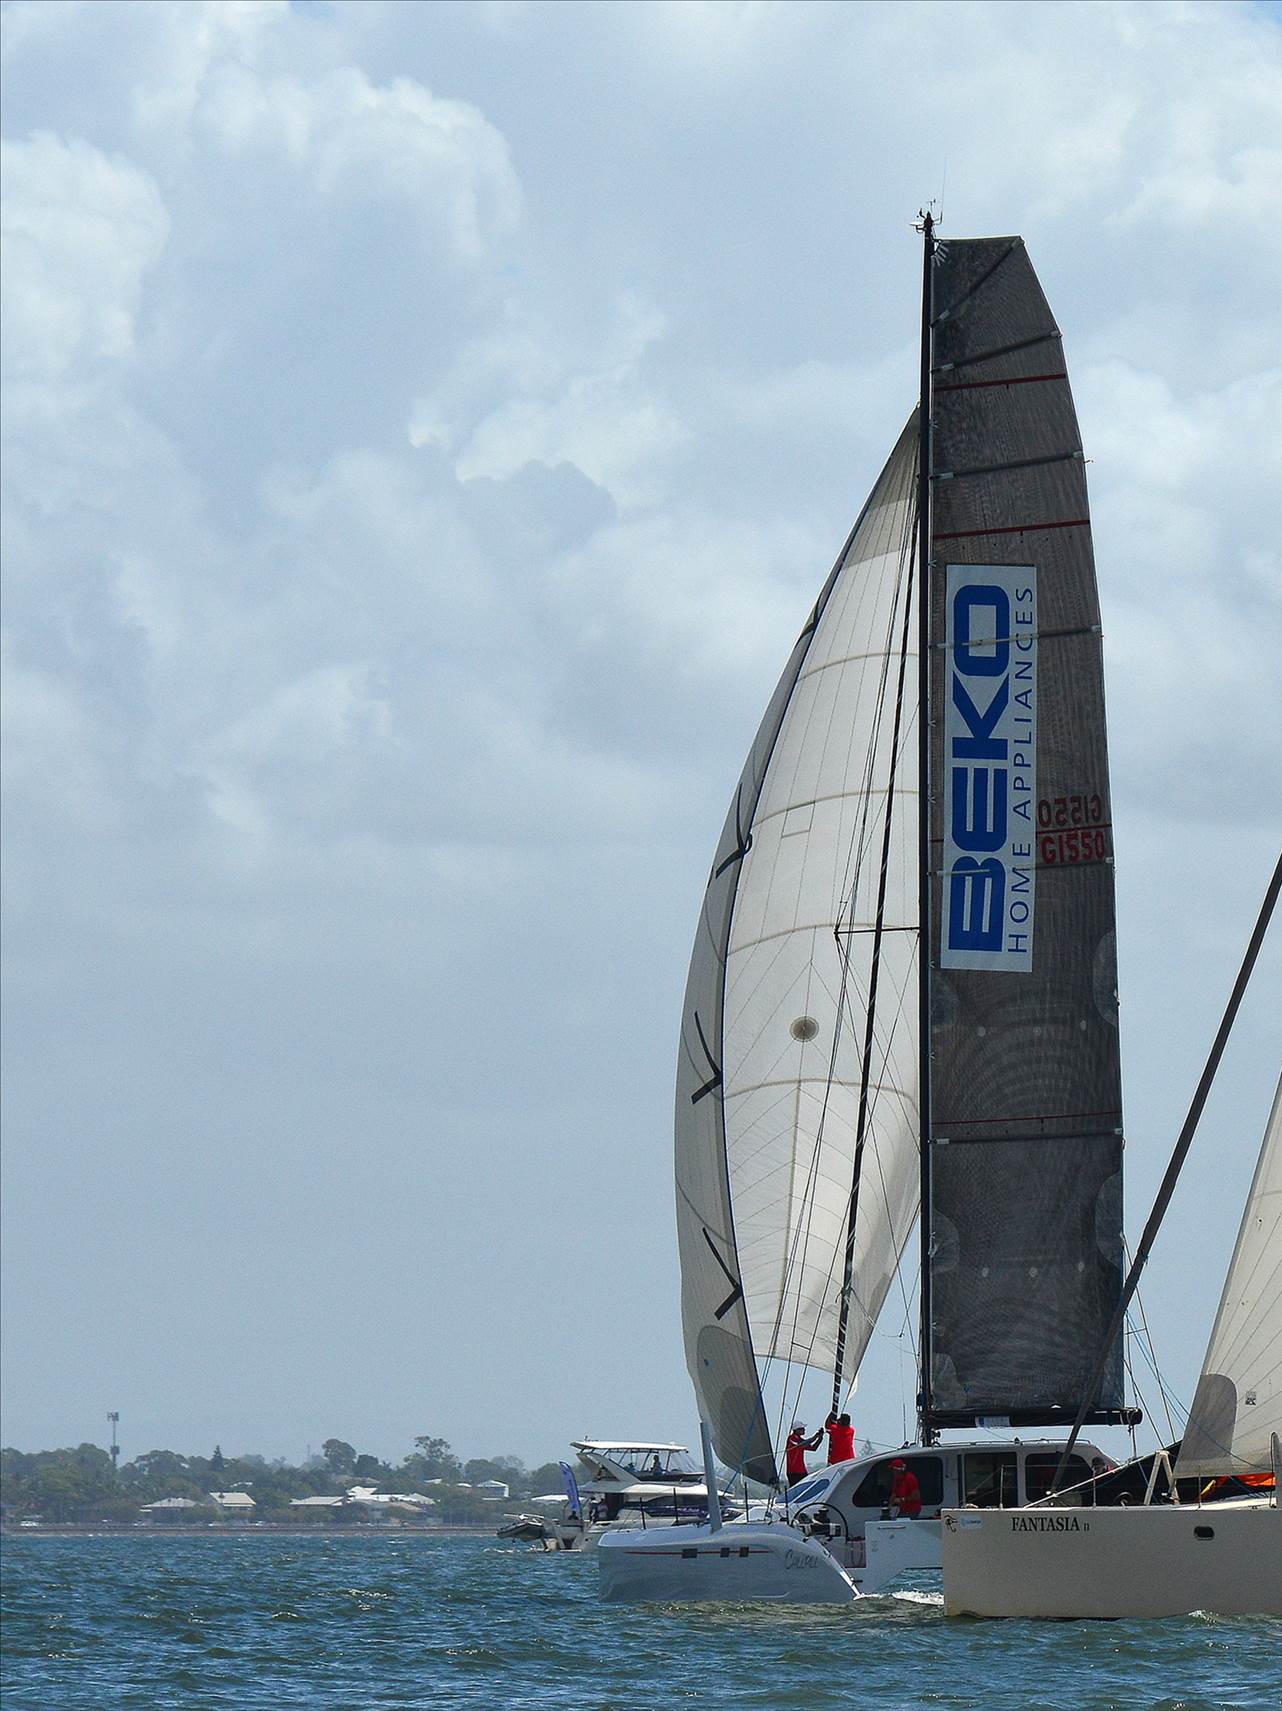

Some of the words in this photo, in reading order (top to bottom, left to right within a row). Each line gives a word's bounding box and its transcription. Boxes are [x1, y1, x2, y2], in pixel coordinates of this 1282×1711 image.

[947, 584, 1010, 952] BEKO
[1013, 587, 1033, 821] APPLIANCES
[1007, 842, 1031, 953] HOME
[1011, 1517, 1080, 1532] FANTASIA
